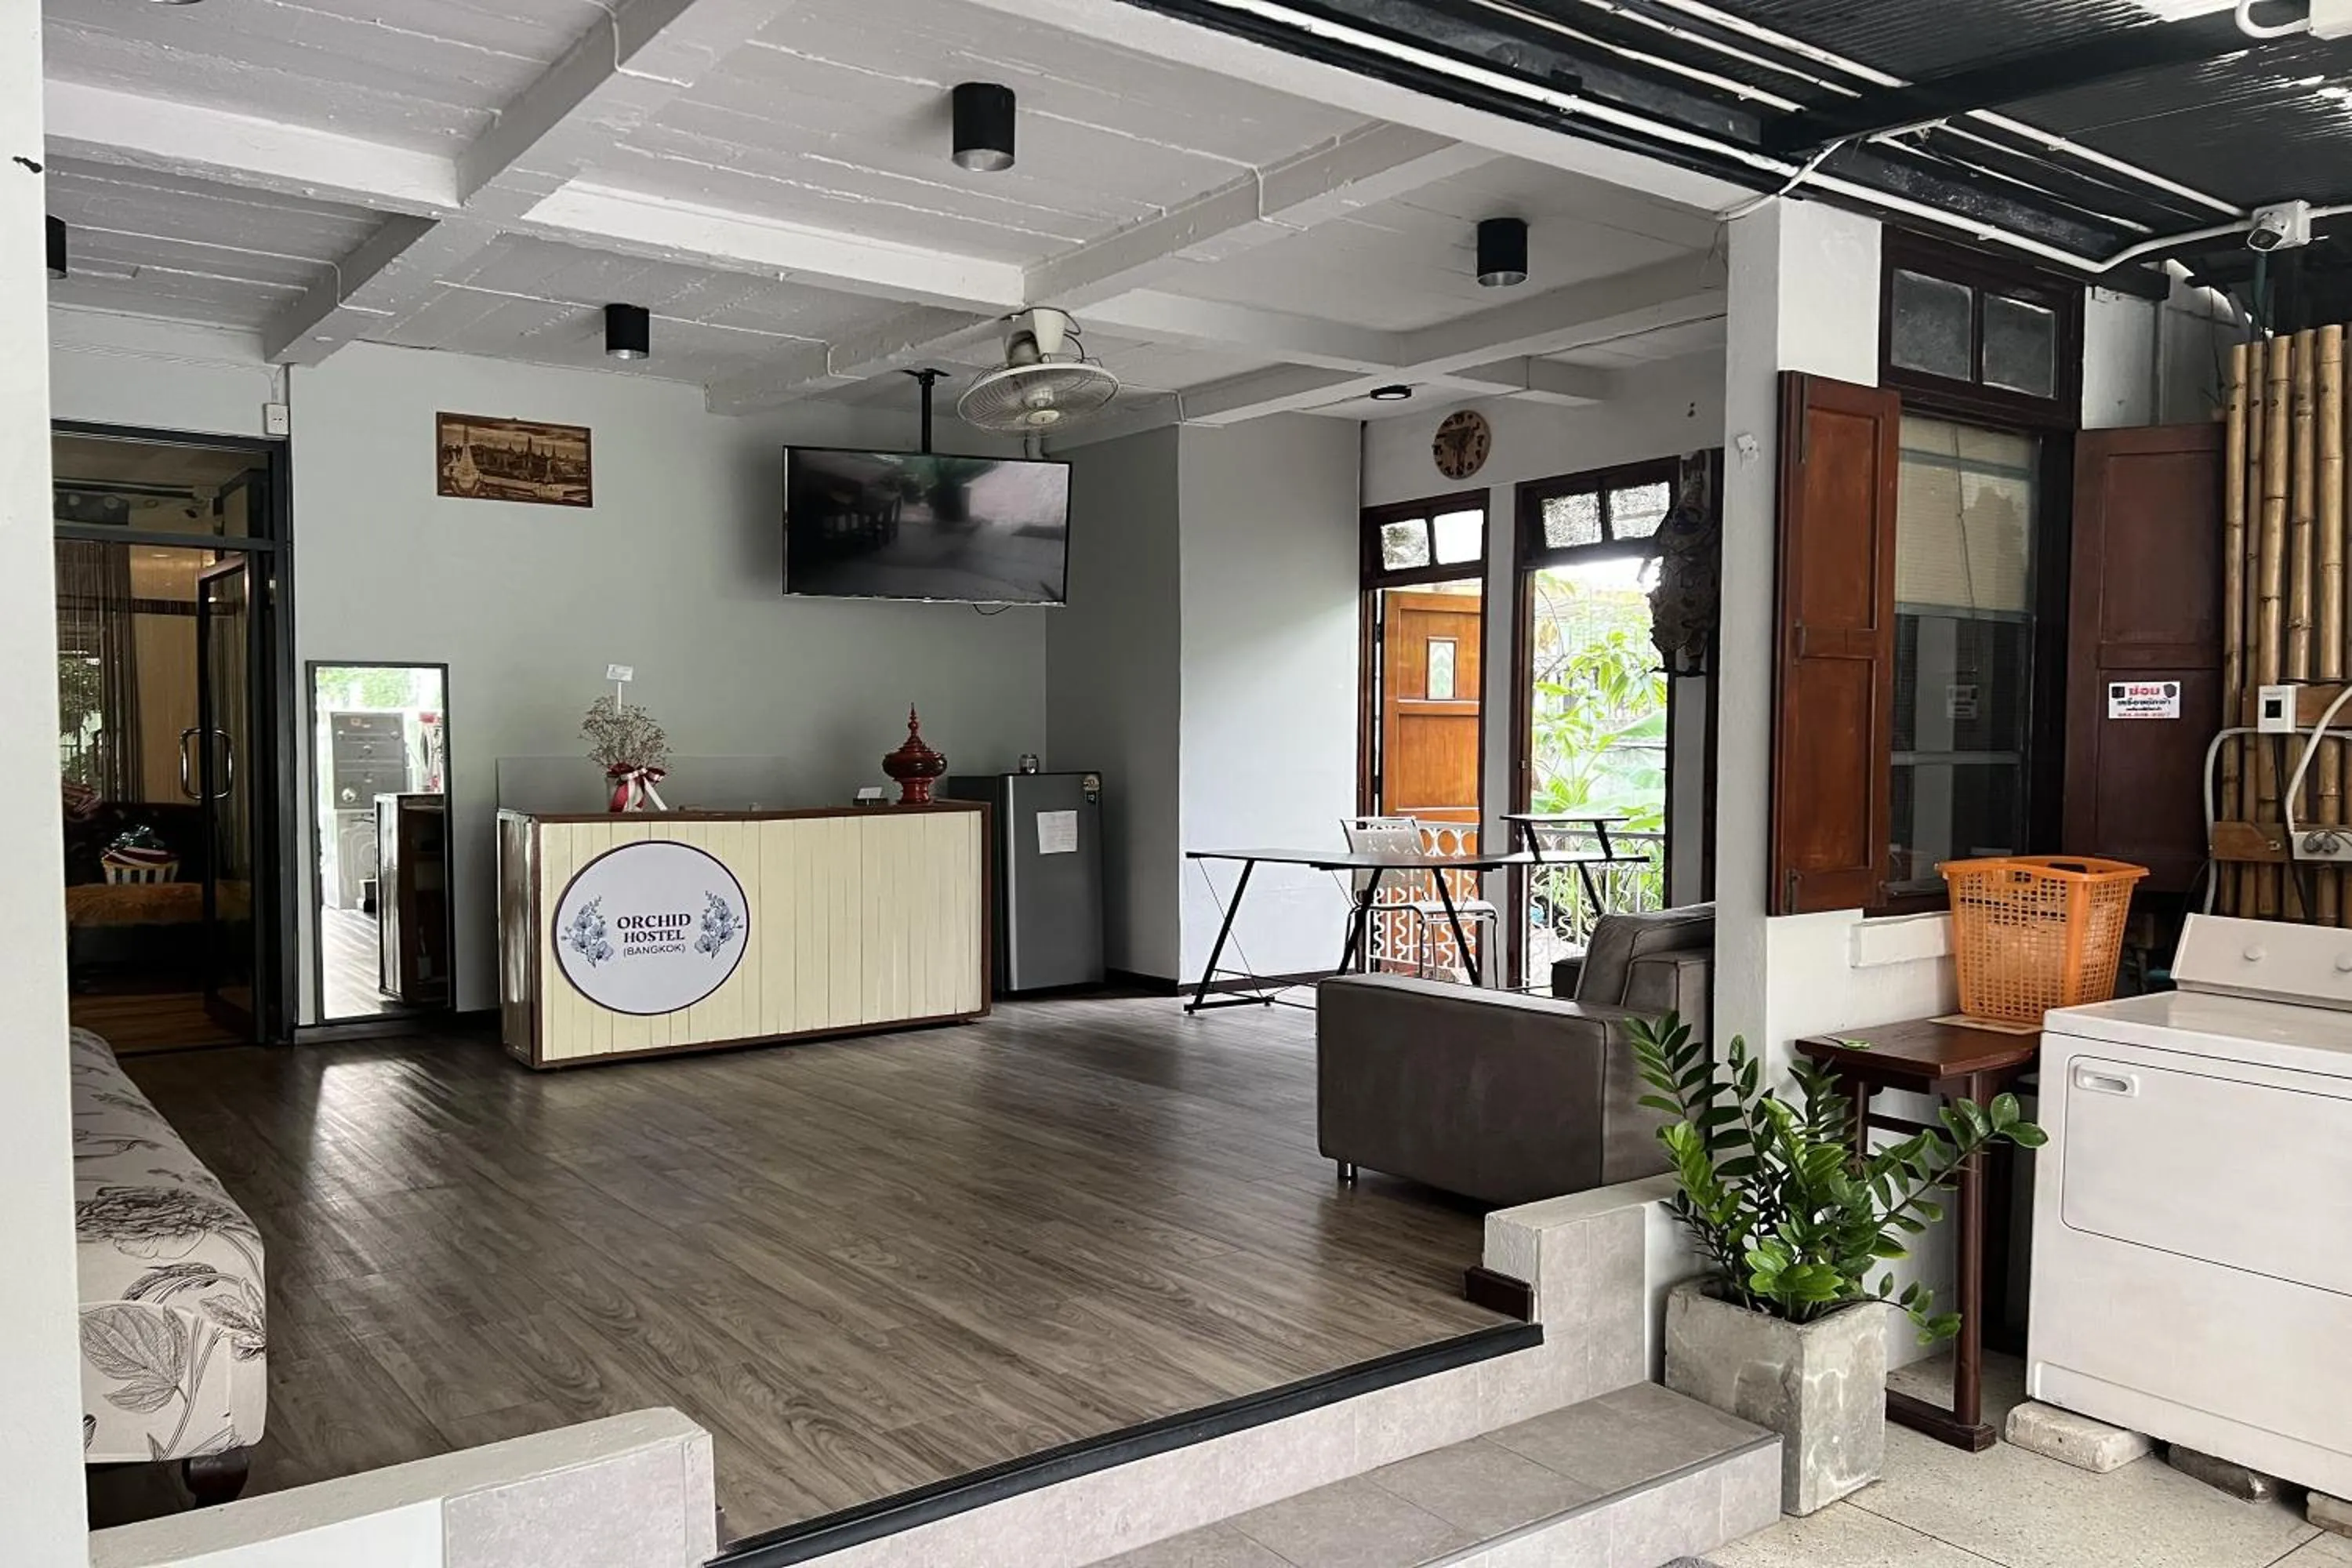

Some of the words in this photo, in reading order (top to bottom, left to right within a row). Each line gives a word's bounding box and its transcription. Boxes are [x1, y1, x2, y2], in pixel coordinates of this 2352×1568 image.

[617, 913, 691, 929] ORCHID
[624, 930, 685, 943] HOSTEL
[623, 944, 686, 956] (BANGKOK)
